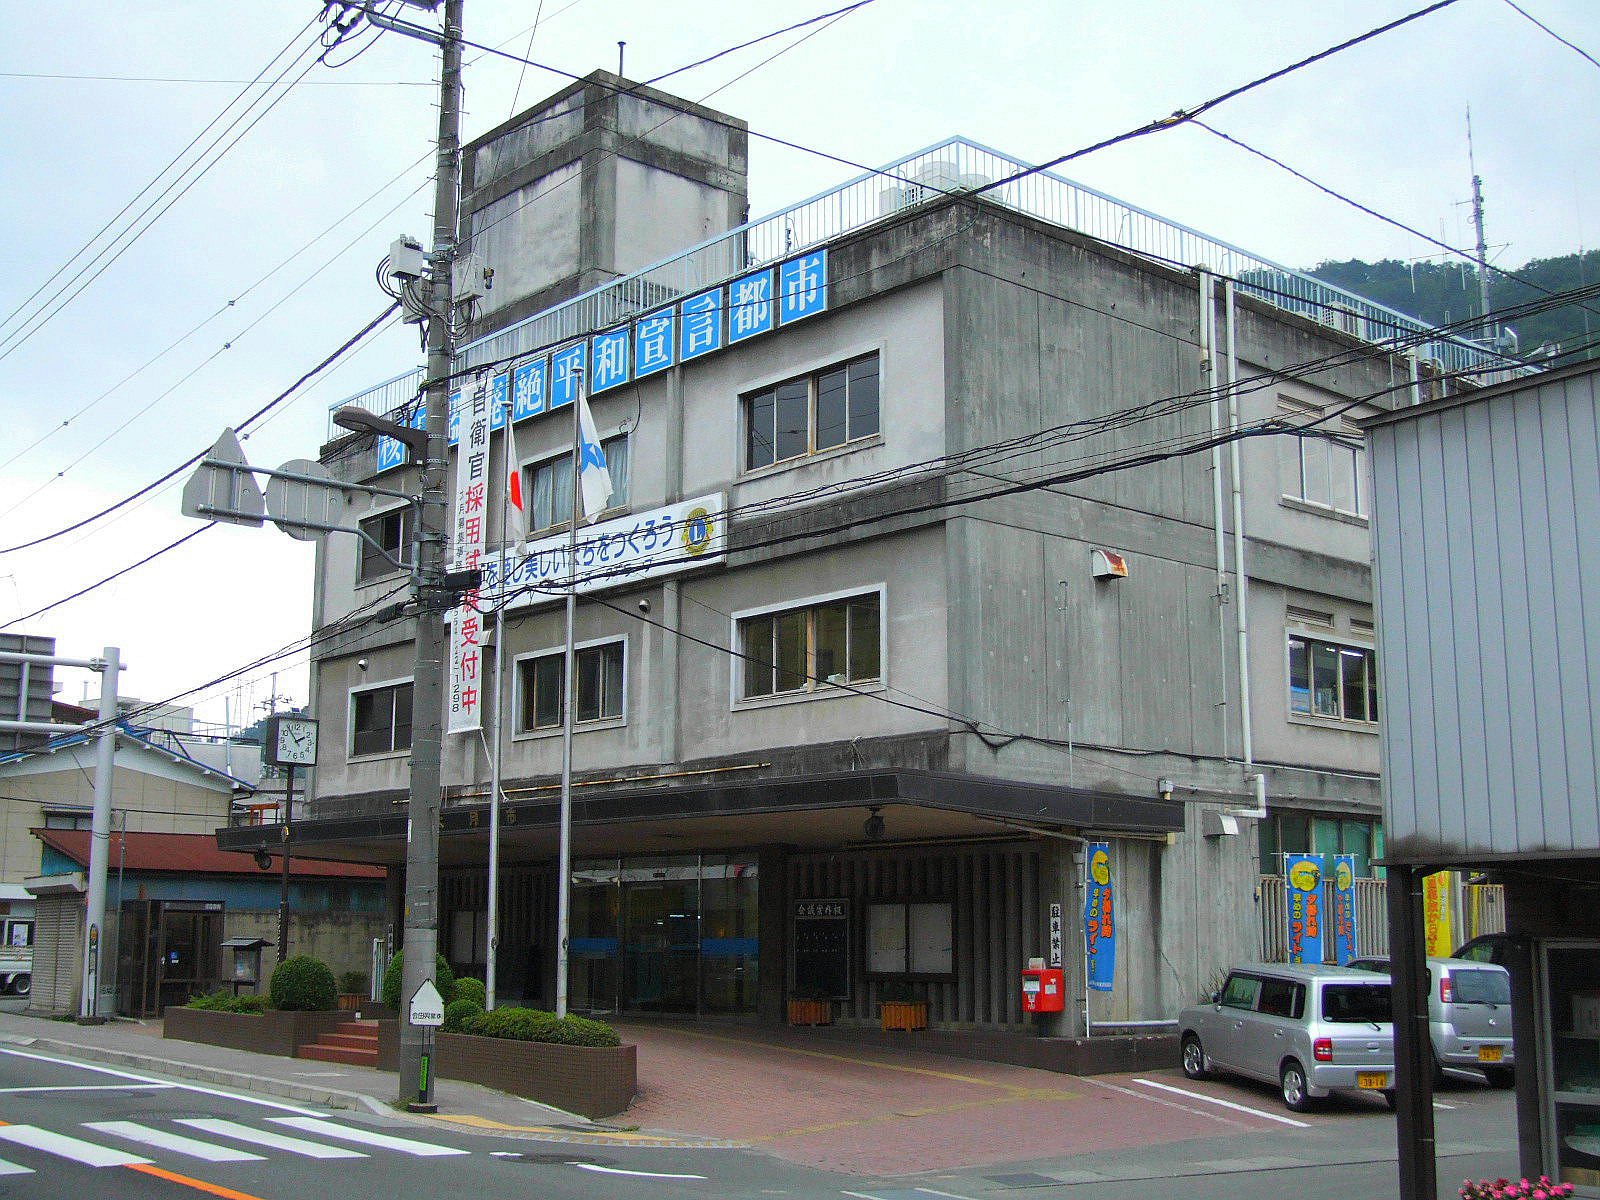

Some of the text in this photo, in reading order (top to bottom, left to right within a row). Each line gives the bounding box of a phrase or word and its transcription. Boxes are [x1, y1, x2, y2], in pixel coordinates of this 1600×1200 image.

[380, 256, 823, 467] 核廃絶平和宣言都市
[1051, 905, 1061, 965] 駐車禁止
